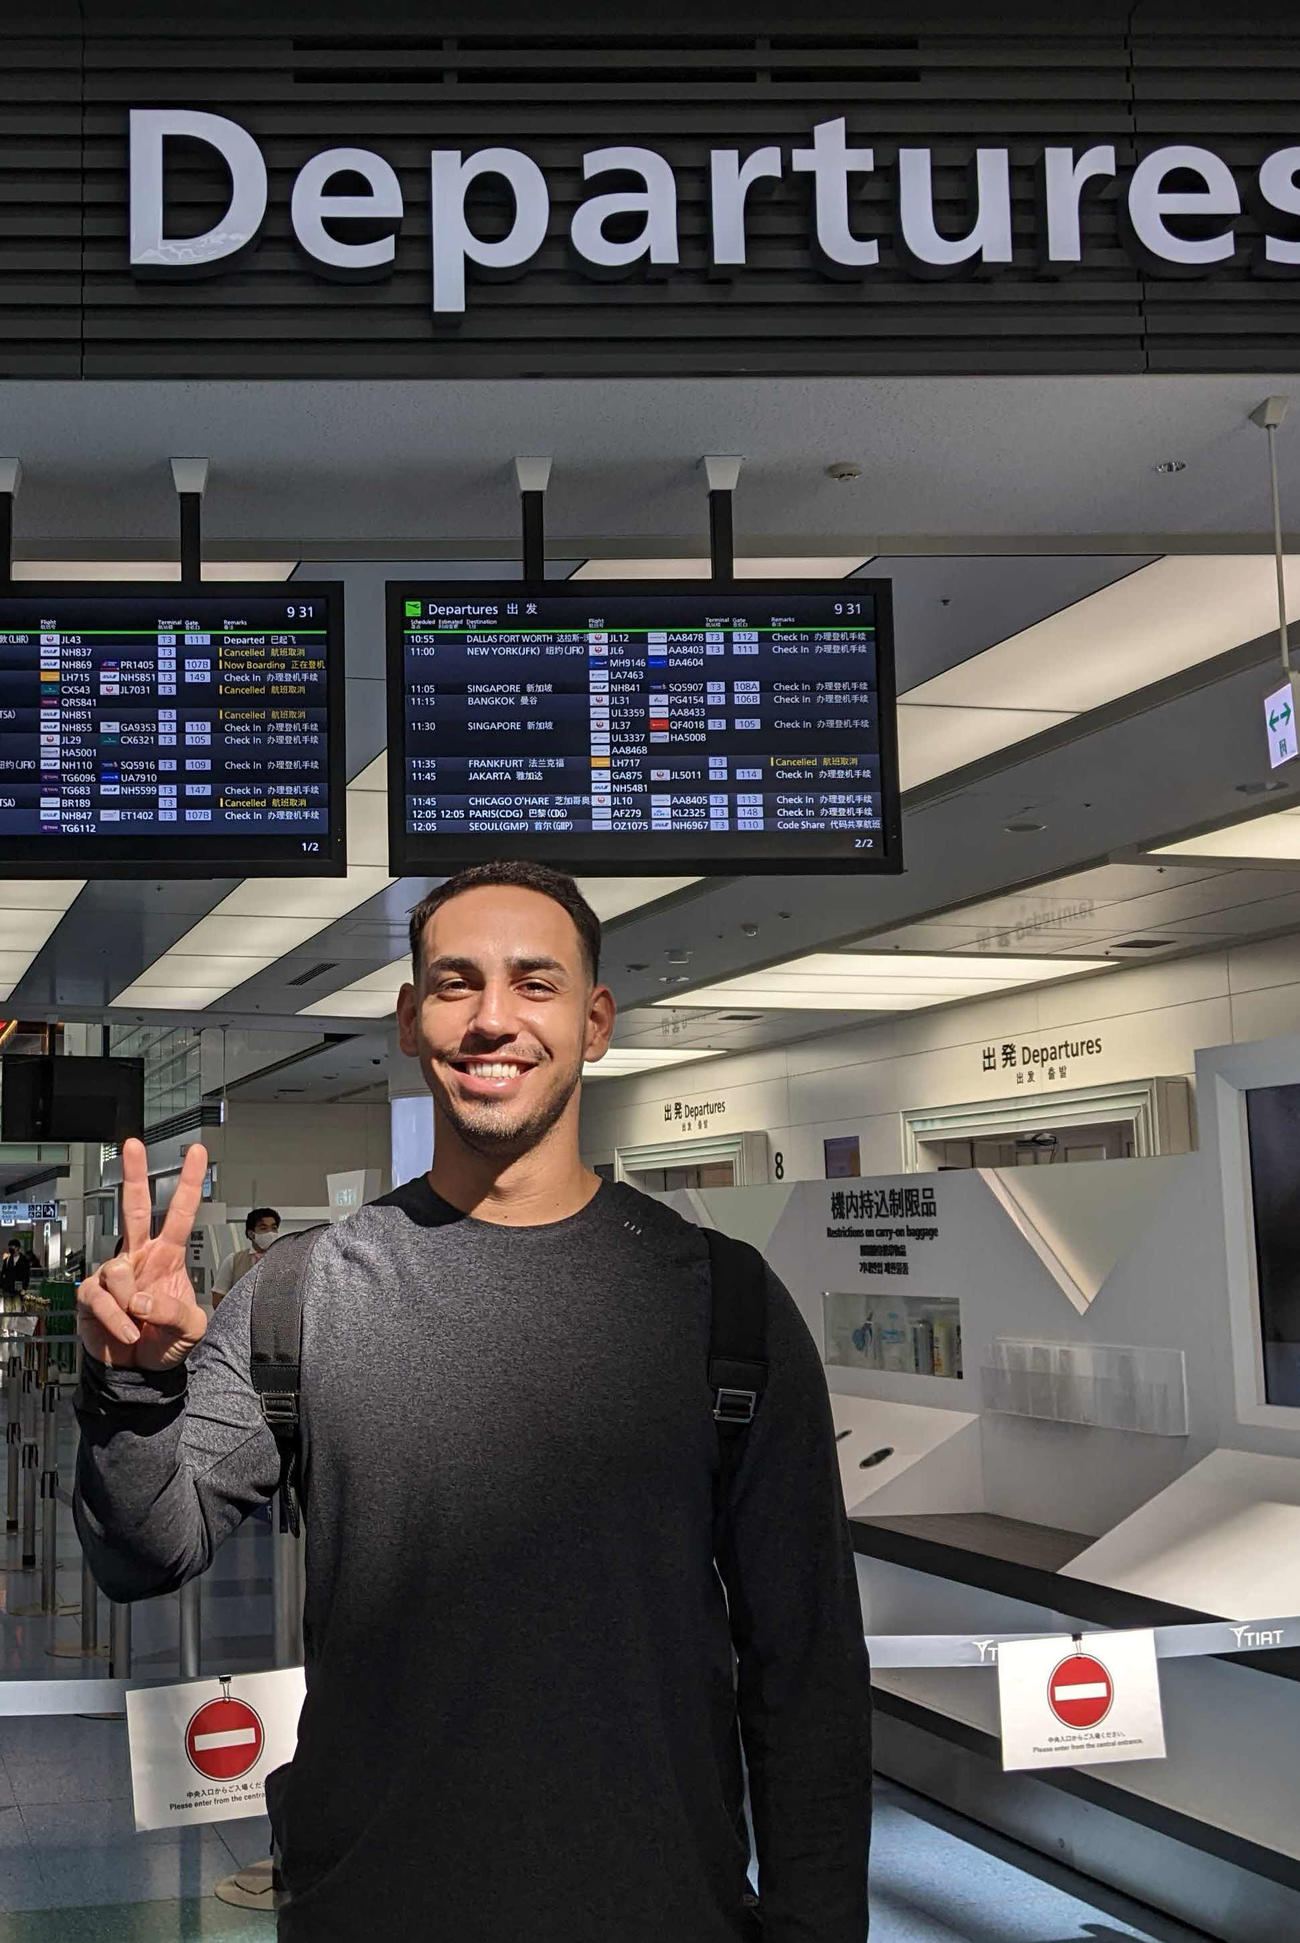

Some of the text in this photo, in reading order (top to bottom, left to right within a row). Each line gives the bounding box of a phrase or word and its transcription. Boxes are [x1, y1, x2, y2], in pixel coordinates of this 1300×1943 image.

[128, 108, 1300, 313] Departures
[429, 604, 498, 615] Departures
[62, 636, 81, 644] JL43
[224, 636, 264, 644] Departed
[411, 635, 434, 643] 10:55
[467, 635, 497, 643] DALLAS
[610, 634, 628, 642] JL12
[62, 648, 92, 656] NH837
[492, 647, 540, 655] YORK(JFK)
[669, 646, 704, 654] AA8403
[62, 661, 92, 669] NH869
[121, 661, 154, 669] PR1405
[247, 661, 285, 671] Boarding
[610, 658, 703, 667] MH9146 BA4604
[253, 674, 260, 682] In
[611, 671, 643, 679] LA7463
[61, 686, 149, 694] CX543 JL7031
[412, 685, 434, 693] 11:05
[527, 684, 552, 692] 新加坡
[611, 684, 639, 692] NH841
[669, 683, 703, 691] SQ5907
[468, 697, 515, 705] BANGKOK
[62, 711, 91, 719] NH851
[611, 708, 705, 717] UL3359 AA8433
[121, 724, 156, 732] GA9353
[412, 722, 435, 730] 11:30
[468, 722, 521, 730] SINGAPORE
[527, 721, 553, 729] 新加坡
[670, 721, 704, 729] QF4018
[62, 736, 81, 744] JL29
[121, 736, 153, 744] CX6321
[612, 734, 645, 742] UL3337
[62, 749, 96, 757] HA5001
[612, 746, 647, 754] AA8468
[62, 761, 92, 769] NH110
[121, 761, 155, 769] SQ5916
[412, 760, 435, 768] 11:35
[529, 759, 564, 767] 法兰克福
[612, 759, 640, 767] LH717
[61, 774, 157, 782] TG6096 UA7910
[469, 772, 511, 780] JAKARTA
[671, 771, 700, 779] JL5011
[613, 784, 647, 792] NH5481
[62, 799, 90, 807] BR189
[469, 797, 512, 805] CHICAGO
[515, 797, 549, 805] O'HARE
[613, 797, 632, 805] JL10
[672, 796, 707, 804] AA8405
[62, 812, 92, 820] NH847
[413, 810, 436, 818] 12:05
[441, 810, 464, 818] 12:05
[470, 810, 523, 818] PARIS(CDG)
[613, 809, 641, 817] AF279
[673, 809, 705, 817] KL2325
[61, 824, 96, 832] TG6112
[413, 823, 436, 831] 12:05
[469, 822, 528, 831] SEOUL(GMP)
[613, 822, 648, 830] OZ1075
[778, 821, 799, 829] Code
[801, 821, 824, 829] Share
[302, 843, 318, 851] 1/2
[855, 839, 873, 847] 2/2
[982, 1038, 1102, 1072] 出発 Departures
[684, 1102, 726, 1120] Departures
[775, 1152, 784, 1179] 8
[831, 1187, 937, 1220] 機内持込制限品
[826, 1226, 864, 1238] Restrictions
[875, 1228, 905, 1240] carry-on
[906, 1225, 939, 1240] baggage
[170, 1792, 266, 1811] Please enter from the centra
